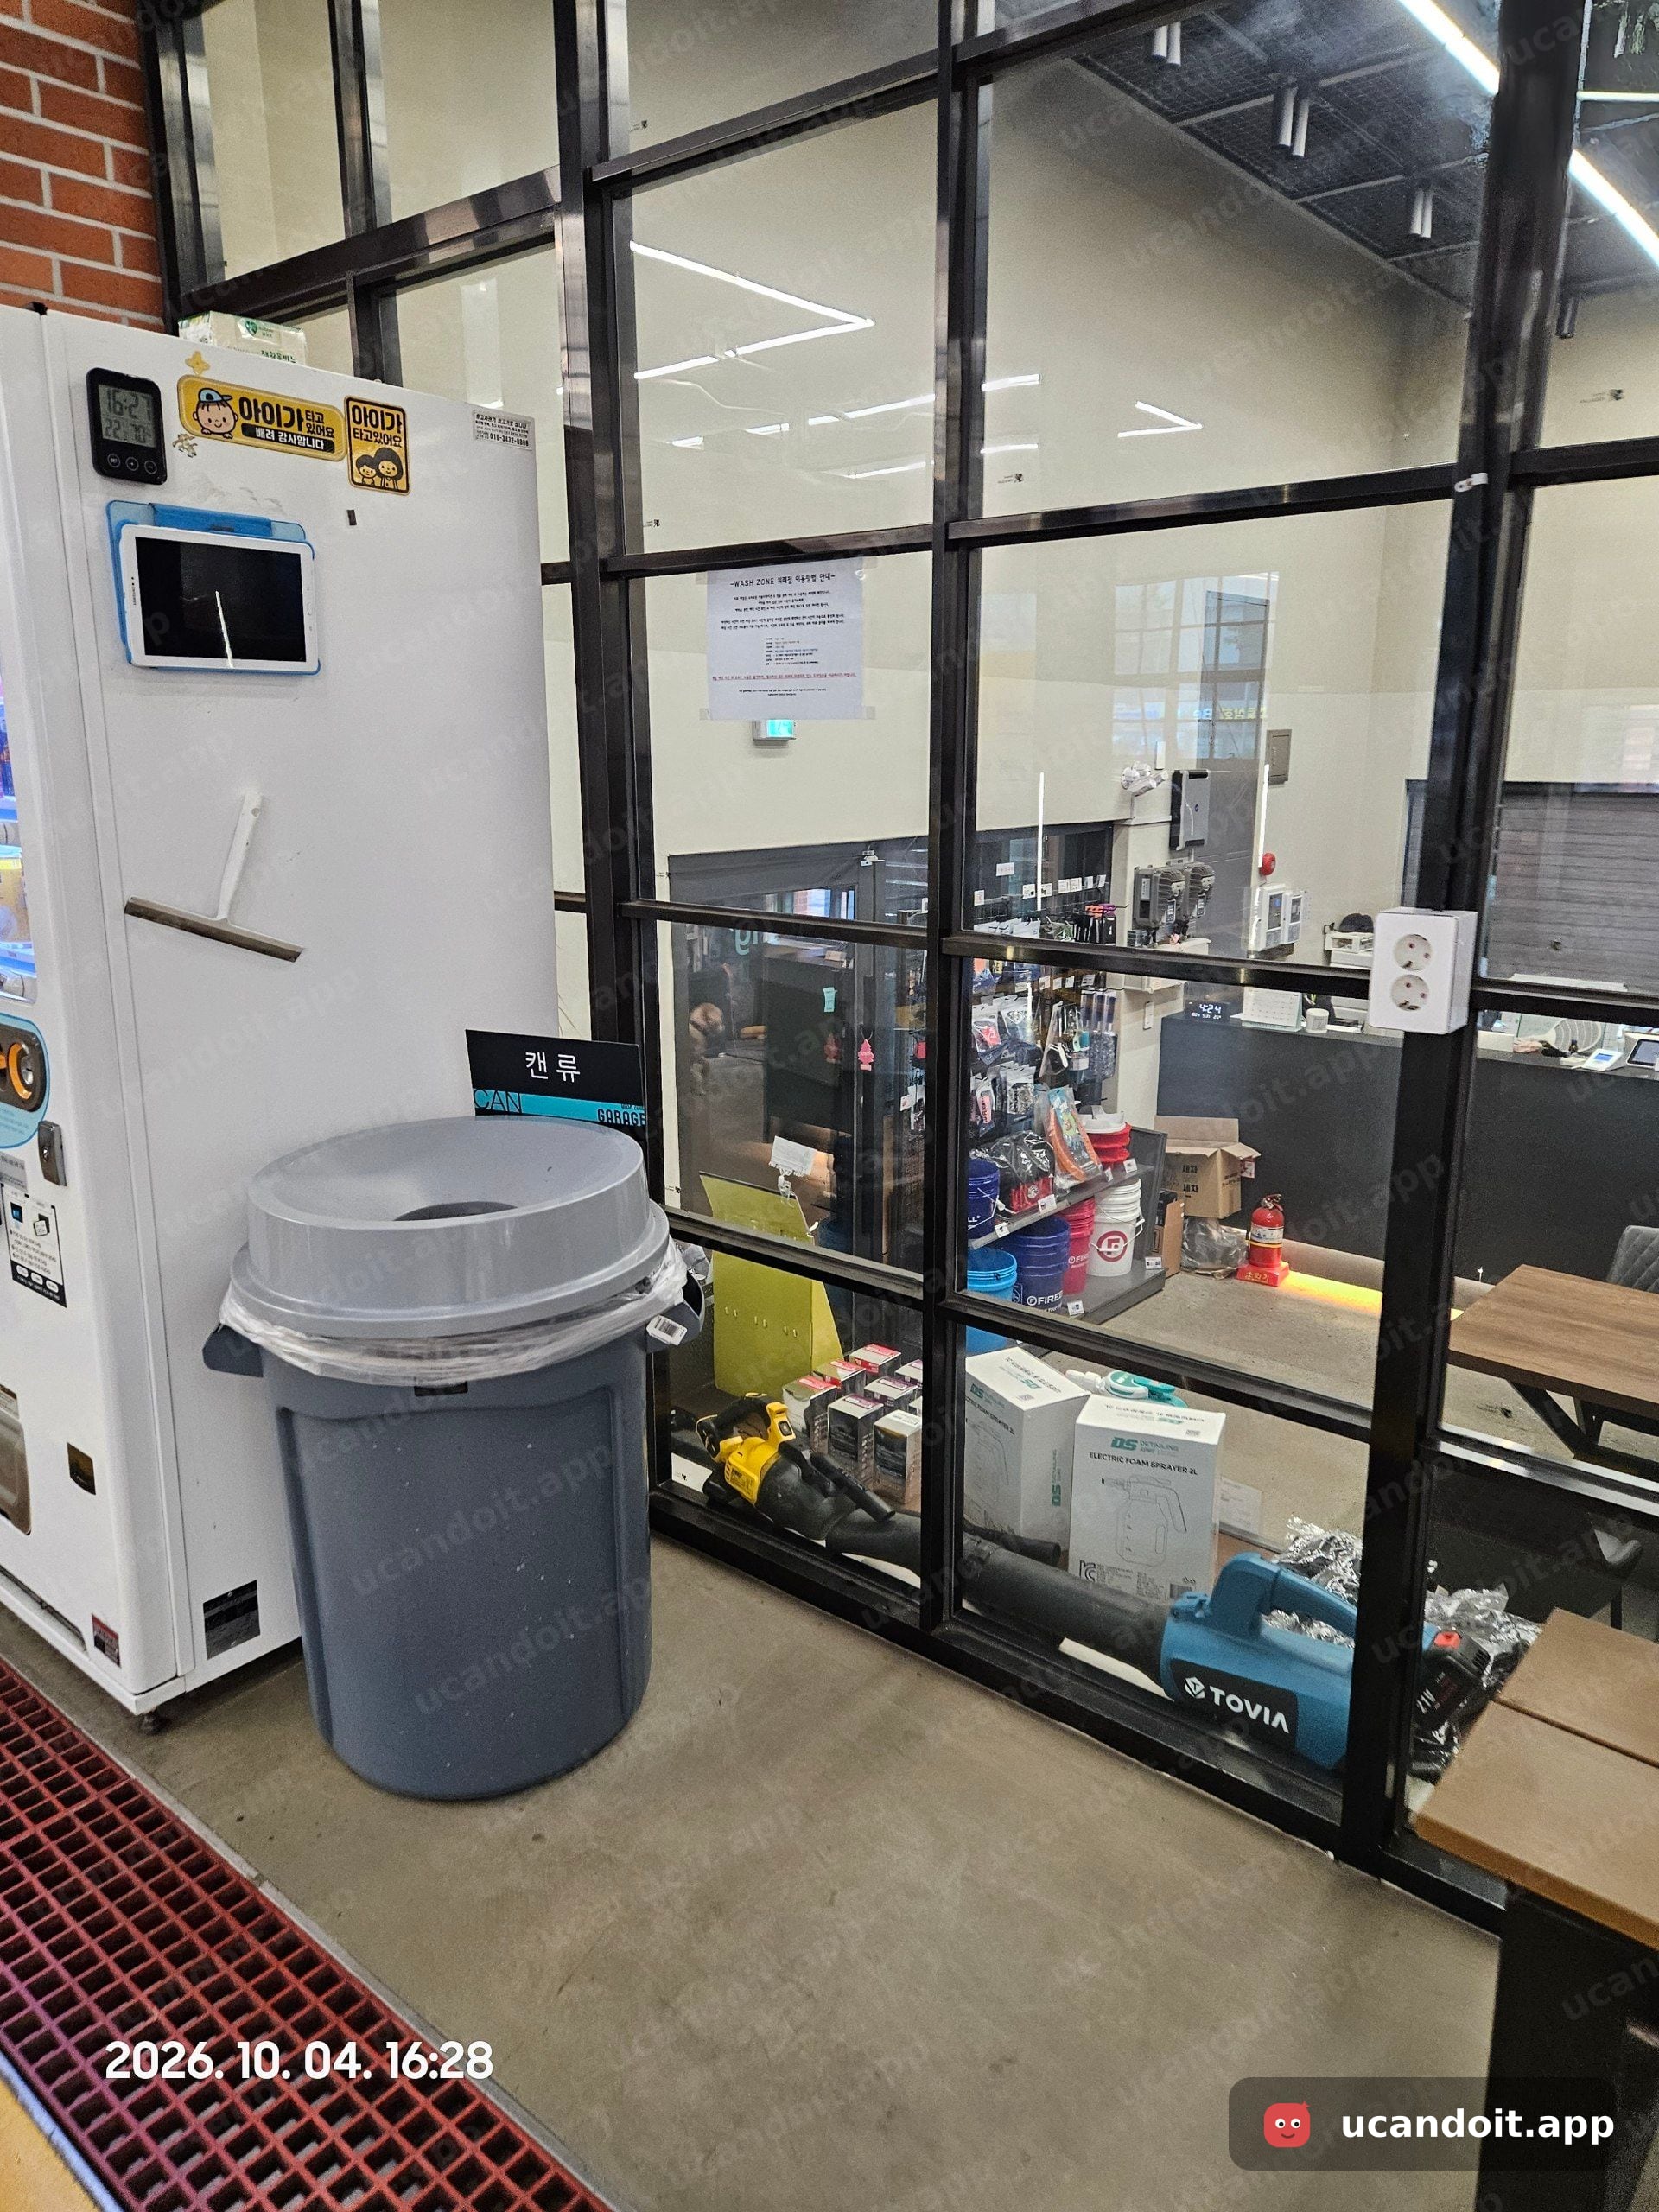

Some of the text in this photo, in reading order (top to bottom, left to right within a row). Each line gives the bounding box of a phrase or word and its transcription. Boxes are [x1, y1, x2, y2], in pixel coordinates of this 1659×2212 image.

[238, 397, 304, 431] 아이가
[305, 410, 324, 424] 타고
[352, 405, 402, 434] 아이가
[256, 427, 325, 450] 배려 감사합니다
[306, 423, 335, 438] 있어요
[353, 427, 403, 448] 타고있어요
[756, 577, 774, 586] ZONE
[473, 1089, 523, 1114] CAN
[597, 1109, 646, 1127] GARAGE
[1245, 1271, 1269, 1282] 소화기
[1089, 1452, 1124, 1464] ELECTRIC
[1125, 1457, 1149, 1468] FOAM
[1150, 1461, 1187, 1474] SPRAYER
[1210, 1685, 1290, 1734] TOVIA
